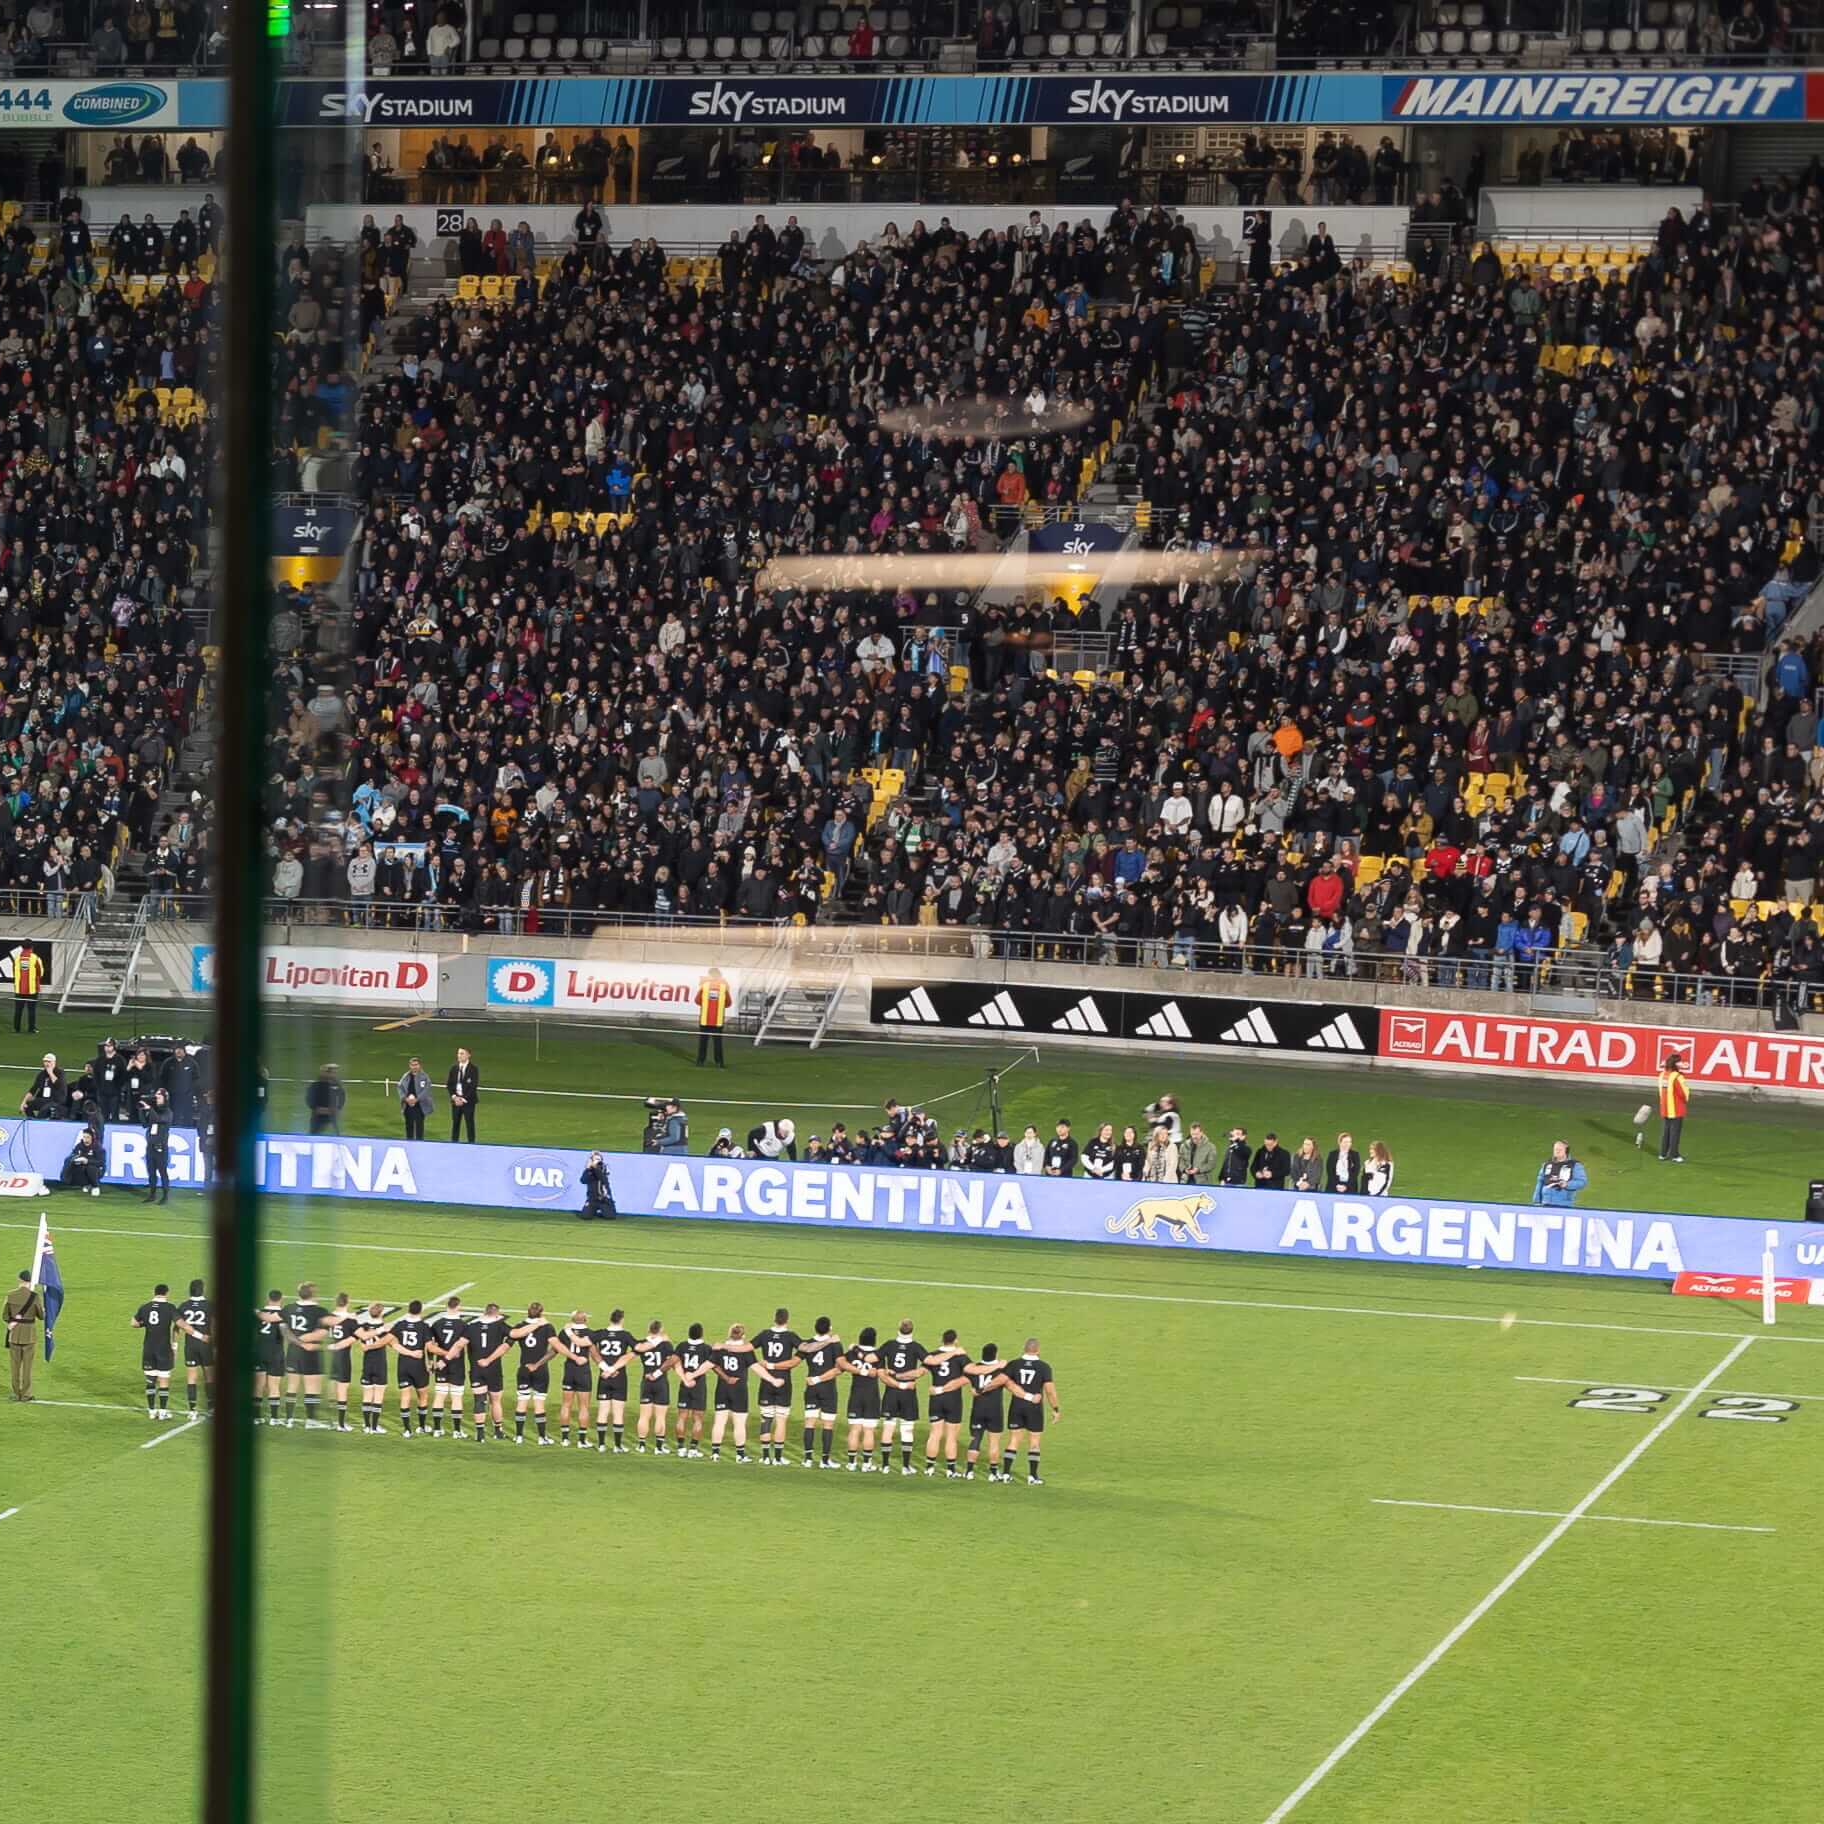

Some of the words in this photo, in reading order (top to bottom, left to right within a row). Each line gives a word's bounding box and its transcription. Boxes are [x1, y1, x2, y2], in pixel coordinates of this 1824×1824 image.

[73, 96, 141, 110] COMBINED
[1131, 94, 1229, 114] STADIUM
[1403, 75, 1799, 118] MAINFREIGHT
[380, 98, 473, 118] STADIUM
[752, 95, 846, 116] STADIUM
[437, 213, 463, 233] 28
[1244, 214, 1257, 236] 2
[1063, 537, 1095, 558] sky
[265, 956, 390, 989] Lipovitan
[395, 961, 428, 990] D
[508, 971, 536, 992] D
[566, 970, 693, 1004] Lipovitan
[1394, 1039, 1423, 1051] ALTRAD
[1432, 1019, 1636, 1069] ALTRAD
[1701, 1038, 1824, 1086] ALTR
[74, 1125, 418, 1195] RGTINA
[514, 1166, 564, 1187] UAR
[654, 1162, 1033, 1232] ARGENTINA
[1278, 1199, 1684, 1274] ARGENTINA
[1745, 1287, 1792, 1298] ALAD
[147, 1310, 159, 1325] 8
[183, 1310, 206, 1326] 22
[289, 1314, 308, 1331] 12
[402, 1330, 418, 1347] 13
[442, 1329, 453, 1344] 7
[479, 1331, 487, 1348] 1
[525, 1332, 537, 1348] 6
[600, 1340, 622, 1357] 23
[767, 1342, 784, 1358] 19
[643, 1351, 662, 1367] 21
[683, 1353, 700, 1369] 14
[723, 1355, 739, 1372] 18
[812, 1350, 825, 1367] 4
[893, 1351, 906, 1367] 5
[938, 1360, 950, 1377] 3
[1019, 1367, 1036, 1385] 17
[1566, 1387, 1800, 1423] 22
